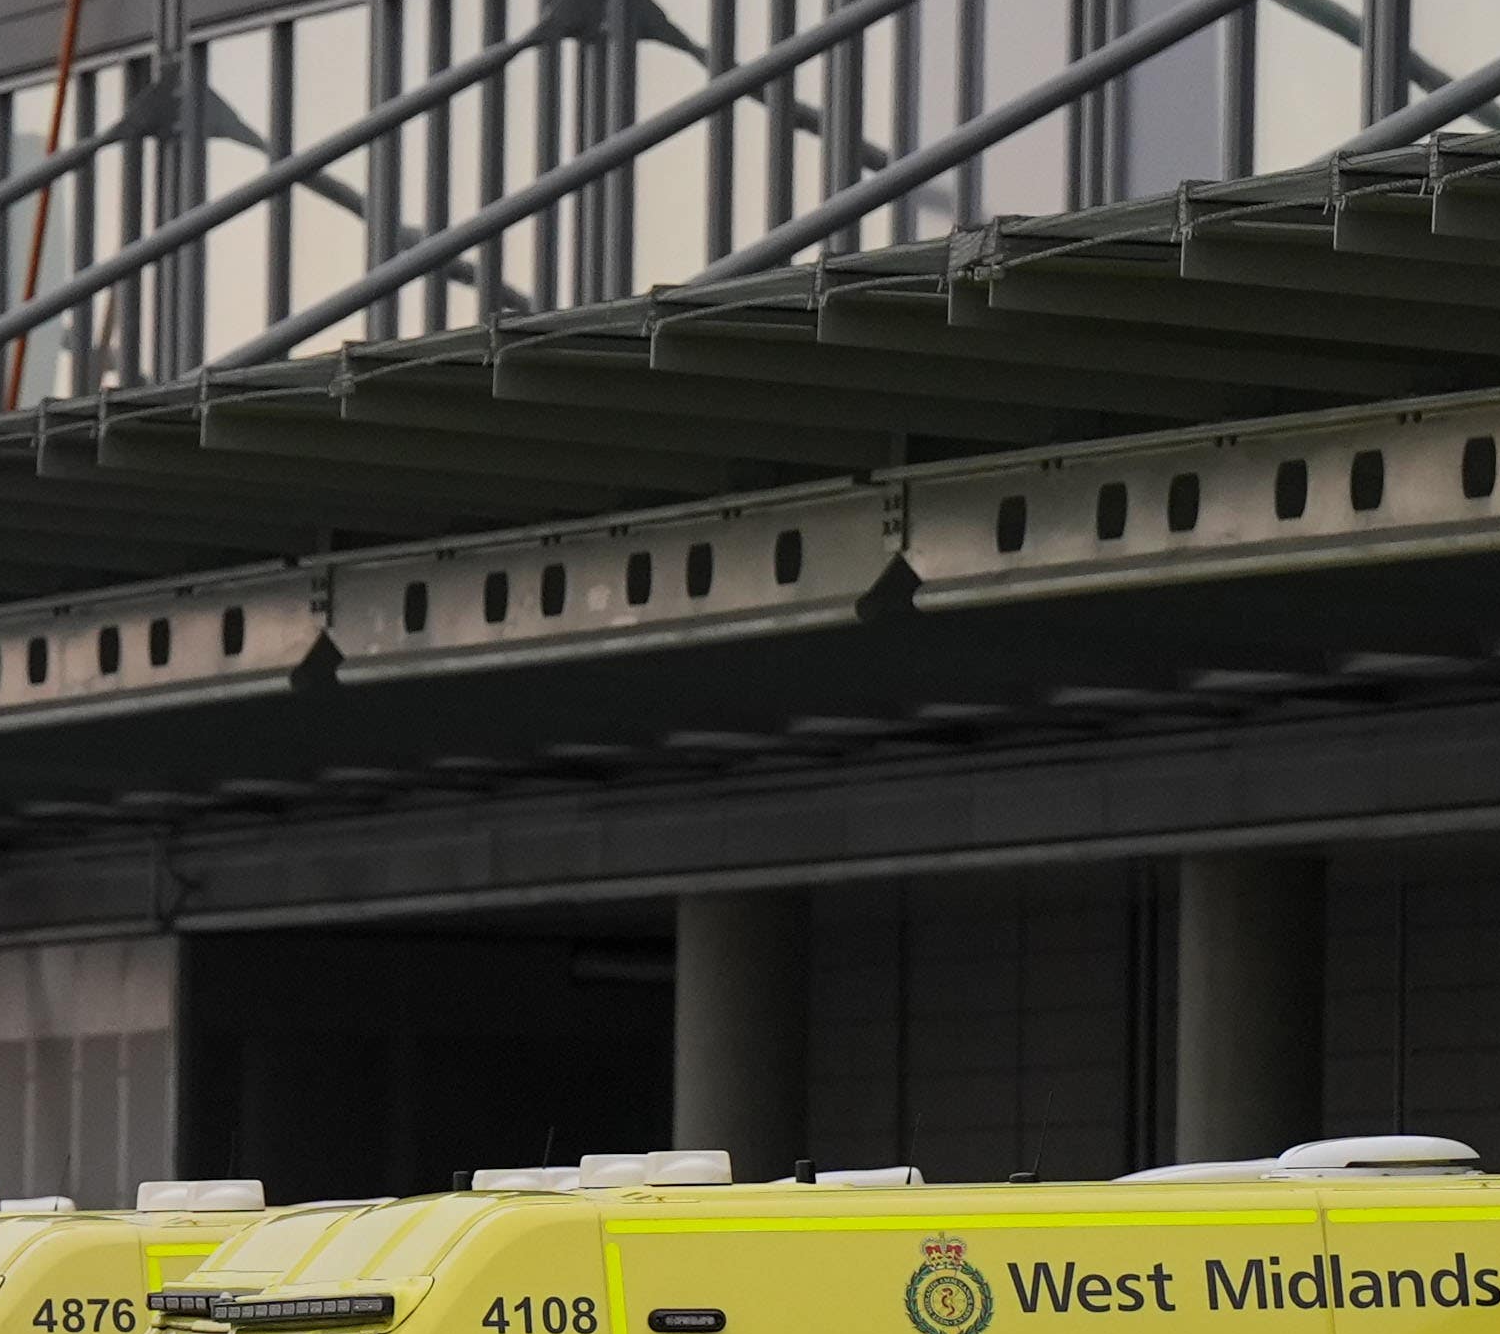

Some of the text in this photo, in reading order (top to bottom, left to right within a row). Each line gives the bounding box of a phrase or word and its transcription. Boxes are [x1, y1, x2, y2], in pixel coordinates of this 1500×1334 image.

[1007, 1262, 1176, 1313] West
[33, 1299, 135, 1333] 4876
[482, 1297, 597, 1334] 4108
